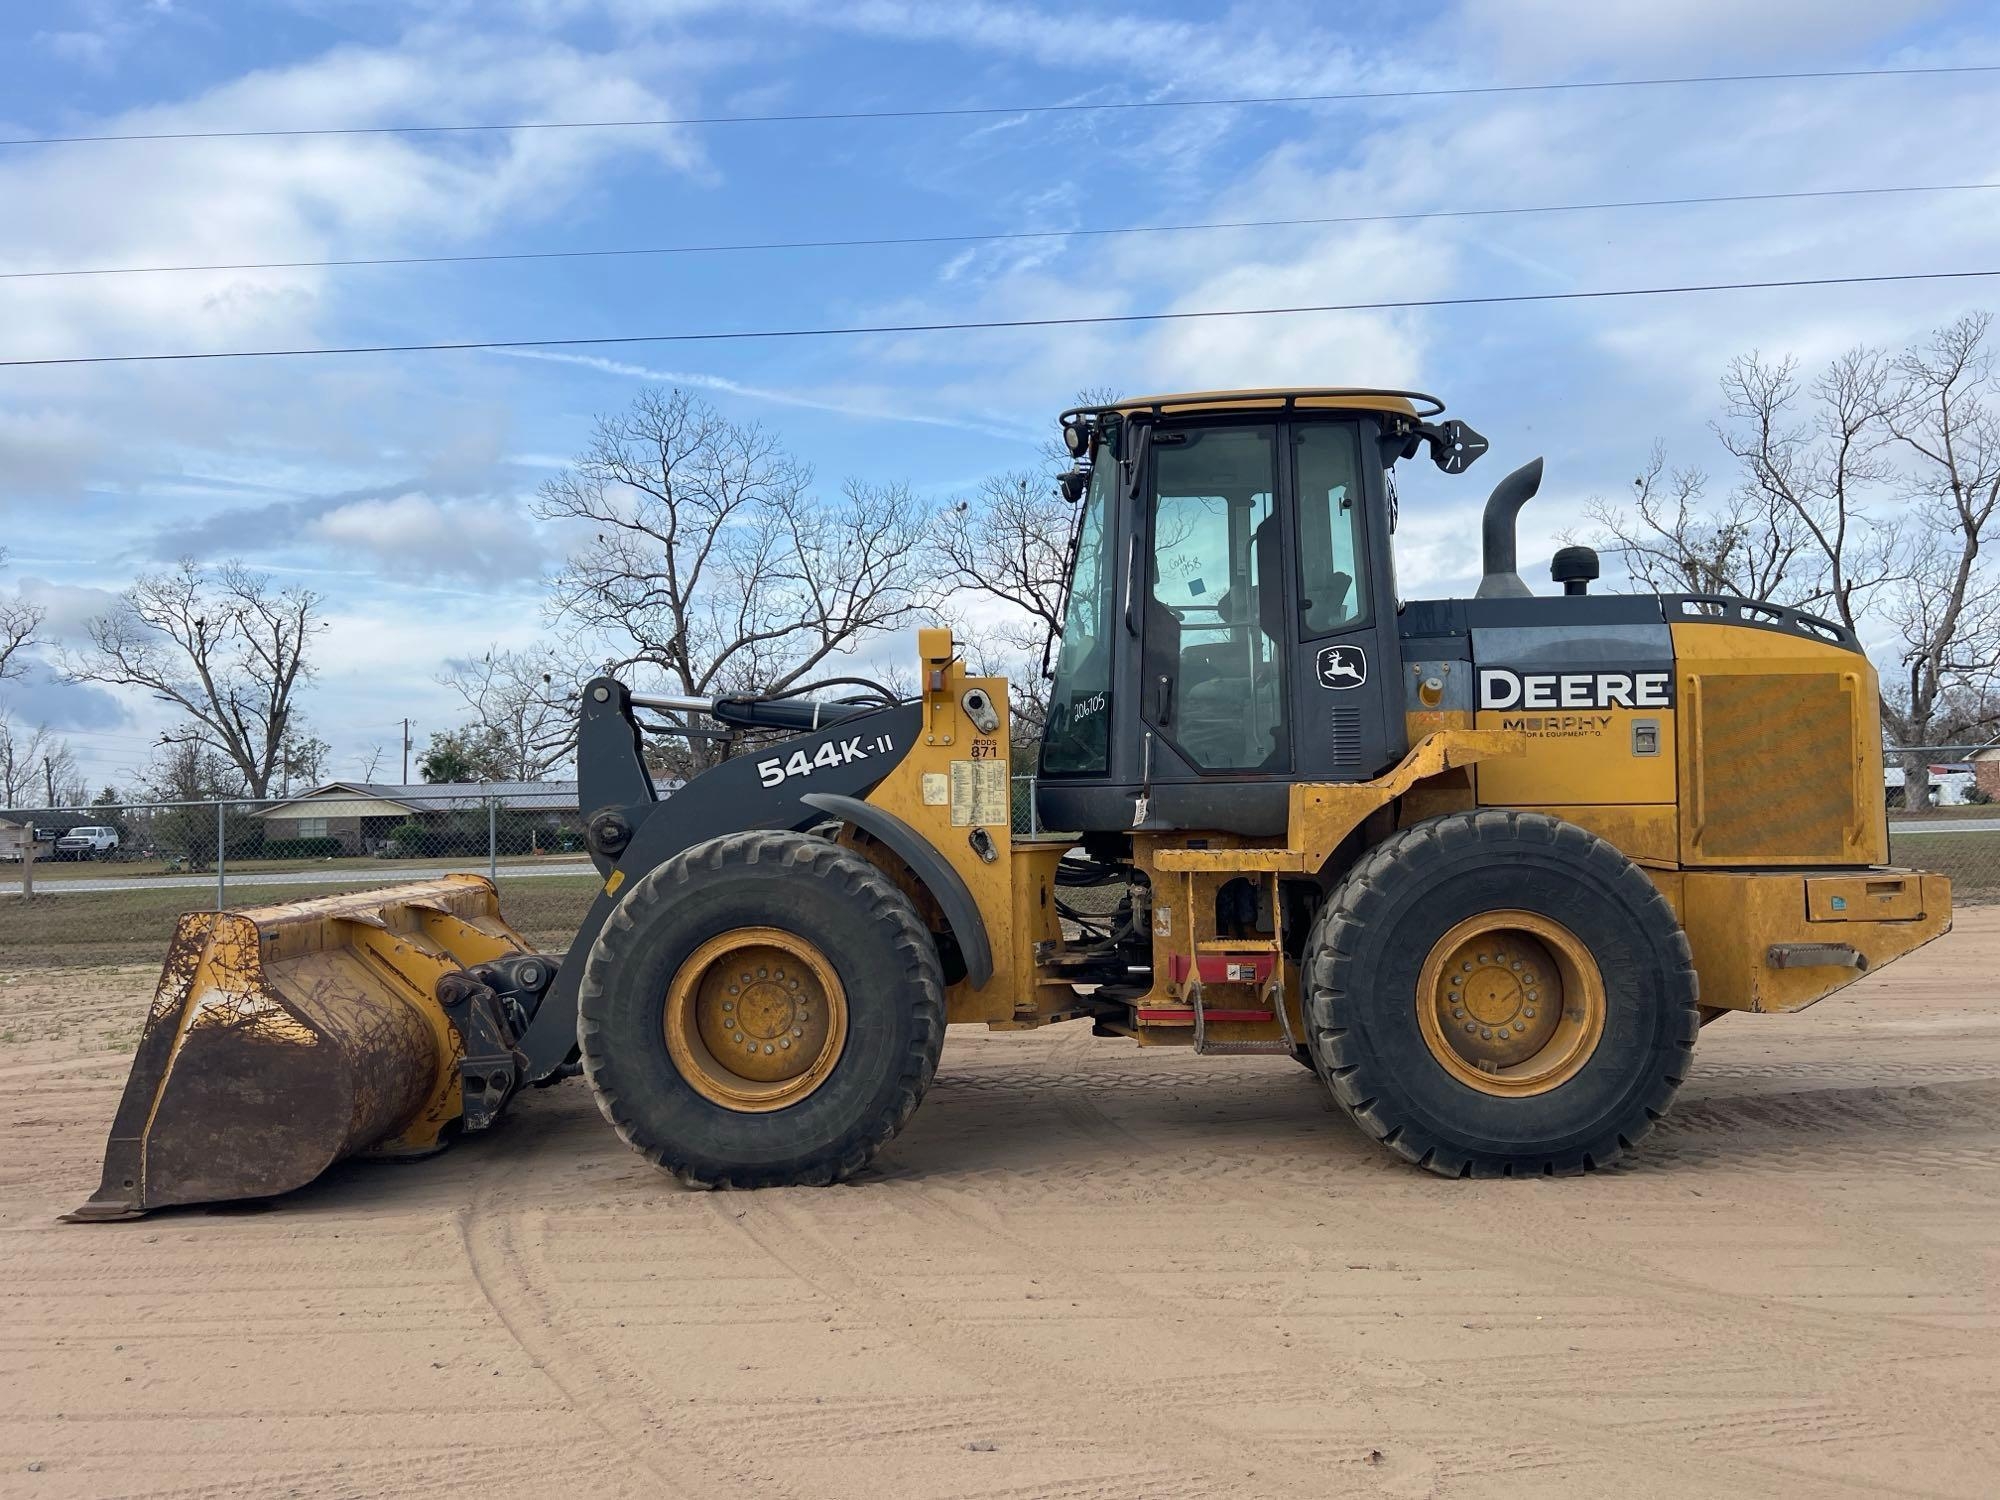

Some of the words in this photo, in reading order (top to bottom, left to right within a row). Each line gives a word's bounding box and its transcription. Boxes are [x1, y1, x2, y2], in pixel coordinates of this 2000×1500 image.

[1480, 669, 1669, 709] DEERE
[1074, 690, 1105, 722] 206705
[1502, 715, 1613, 731] MRPHY
[971, 746, 997, 758] 871
